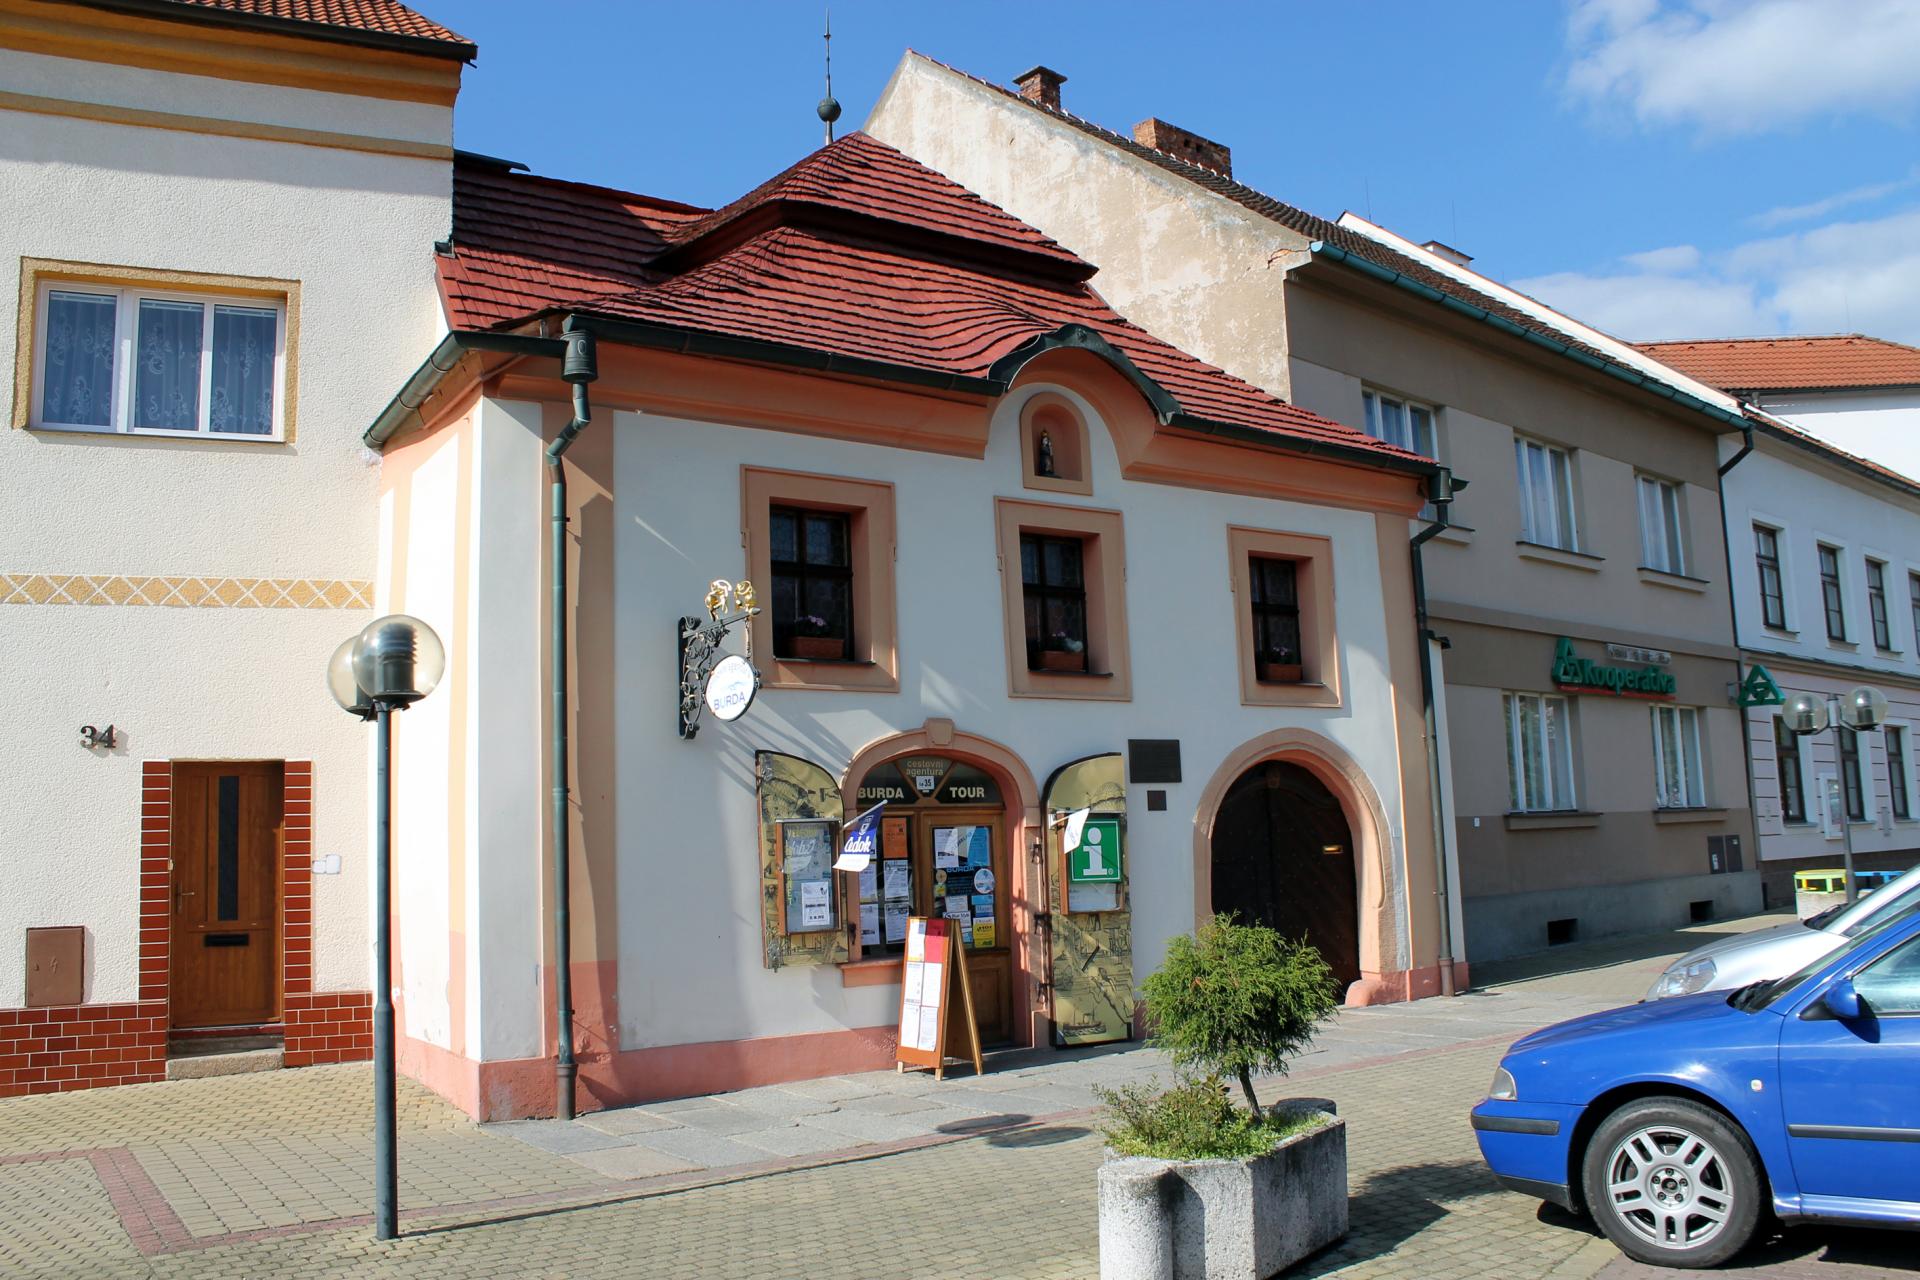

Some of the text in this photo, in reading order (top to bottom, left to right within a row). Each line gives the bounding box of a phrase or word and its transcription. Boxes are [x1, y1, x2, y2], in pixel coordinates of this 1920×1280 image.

[1582, 657, 1677, 697] Kooperativa
[714, 691, 746, 710] BURDA
[80, 724, 116, 749] 34
[857, 787, 985, 799] BURDA TOUR
